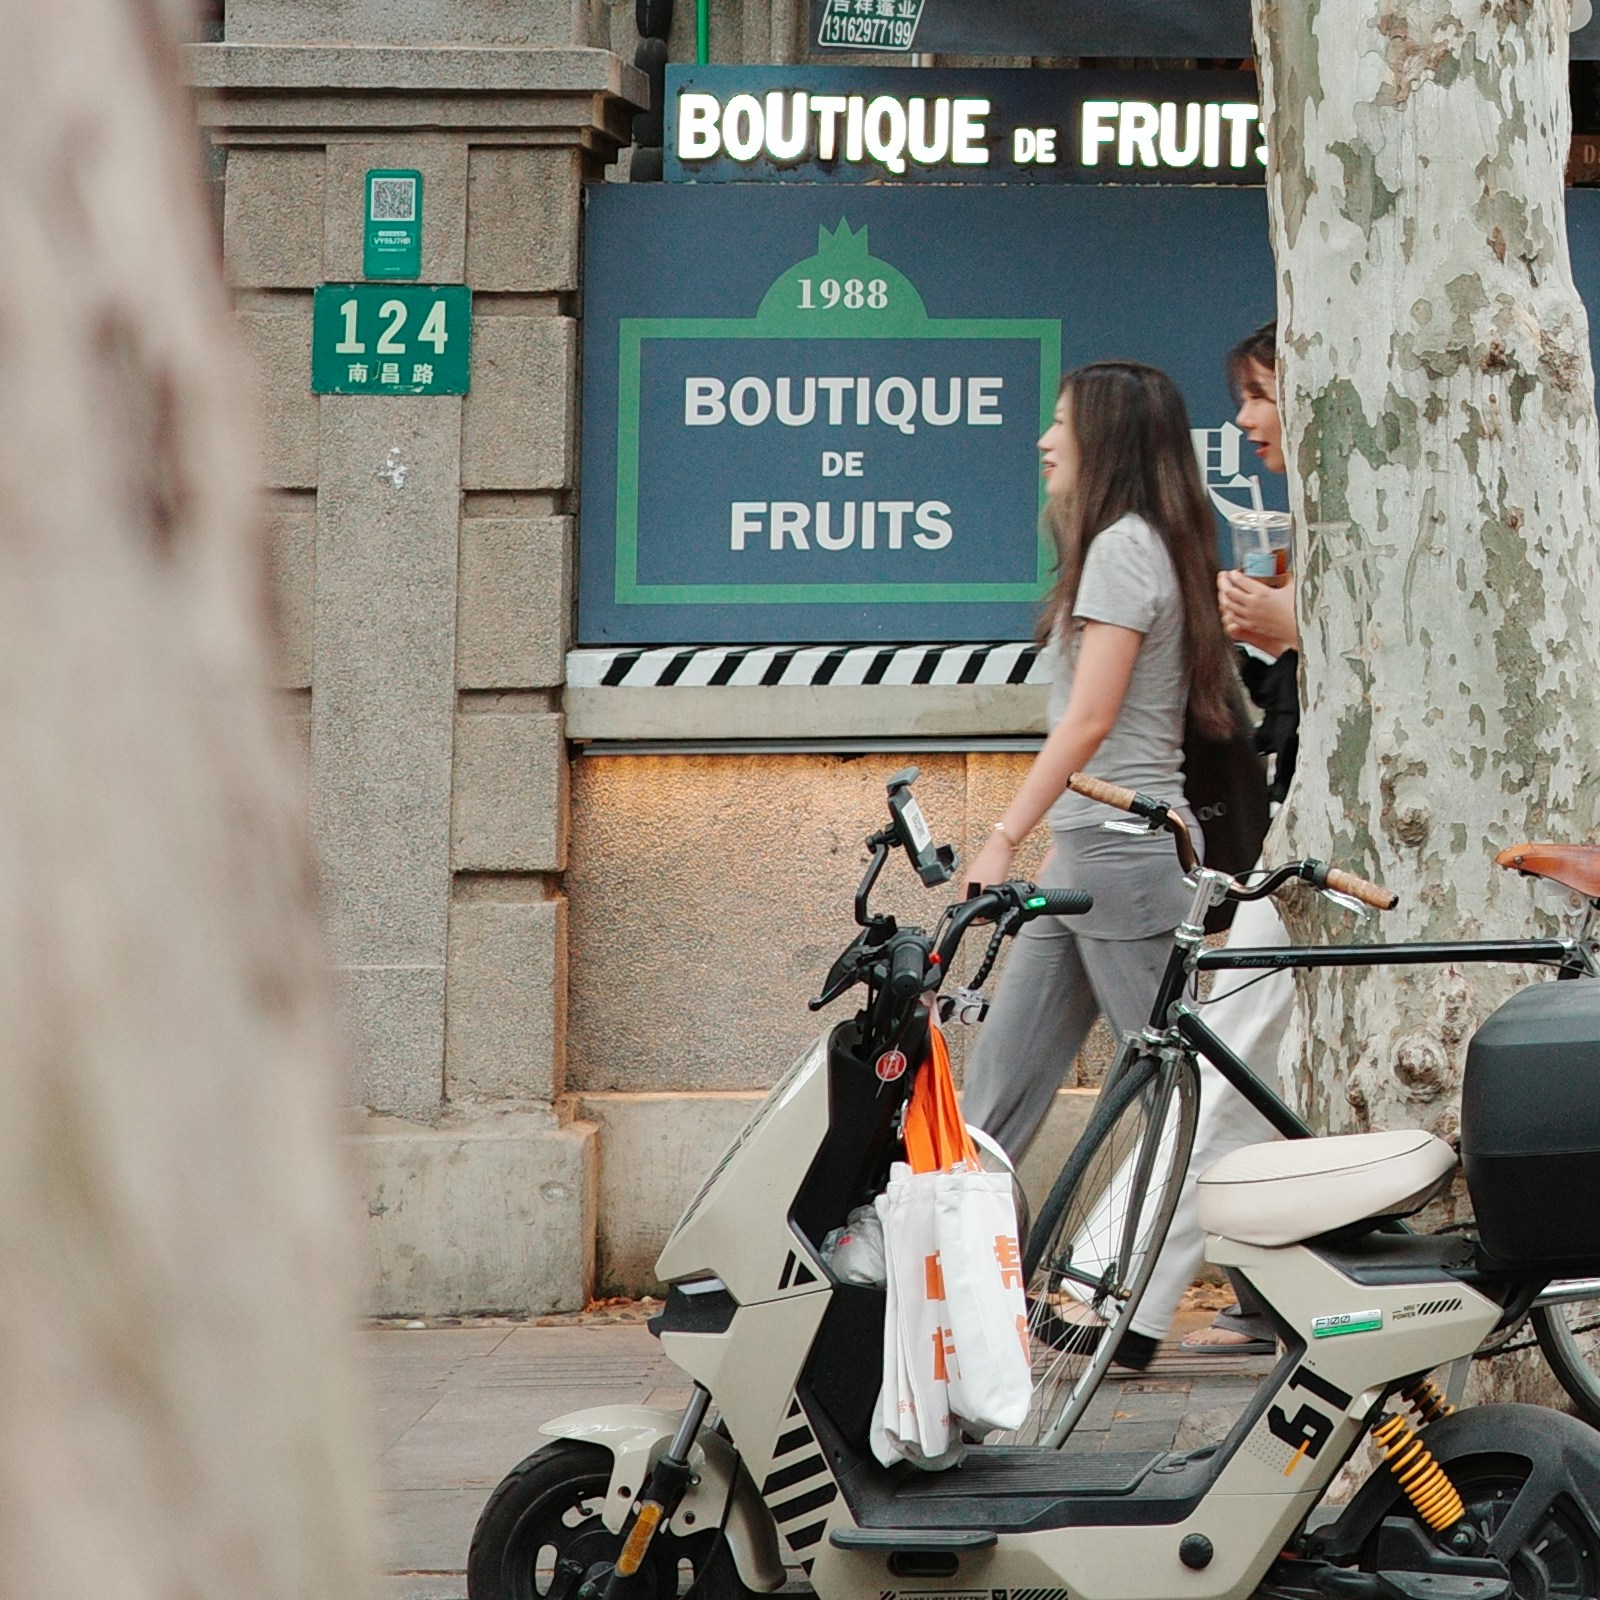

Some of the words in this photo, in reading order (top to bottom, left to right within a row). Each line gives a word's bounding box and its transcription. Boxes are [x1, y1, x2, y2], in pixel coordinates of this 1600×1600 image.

[823, 15, 912, 45] 13162977199
[678, 93, 990, 173] BOUTIQUE
[1014, 128, 1056, 163] DE
[797, 278, 888, 309] 1988
[335, 299, 449, 355] 124
[347, 362, 435, 385] 南昌路
[684, 376, 1003, 434] BOUTIQUE
[822, 451, 864, 477] DE
[730, 500, 953, 551] FRUITS
[1392, 1311, 1416, 1321] POWER
